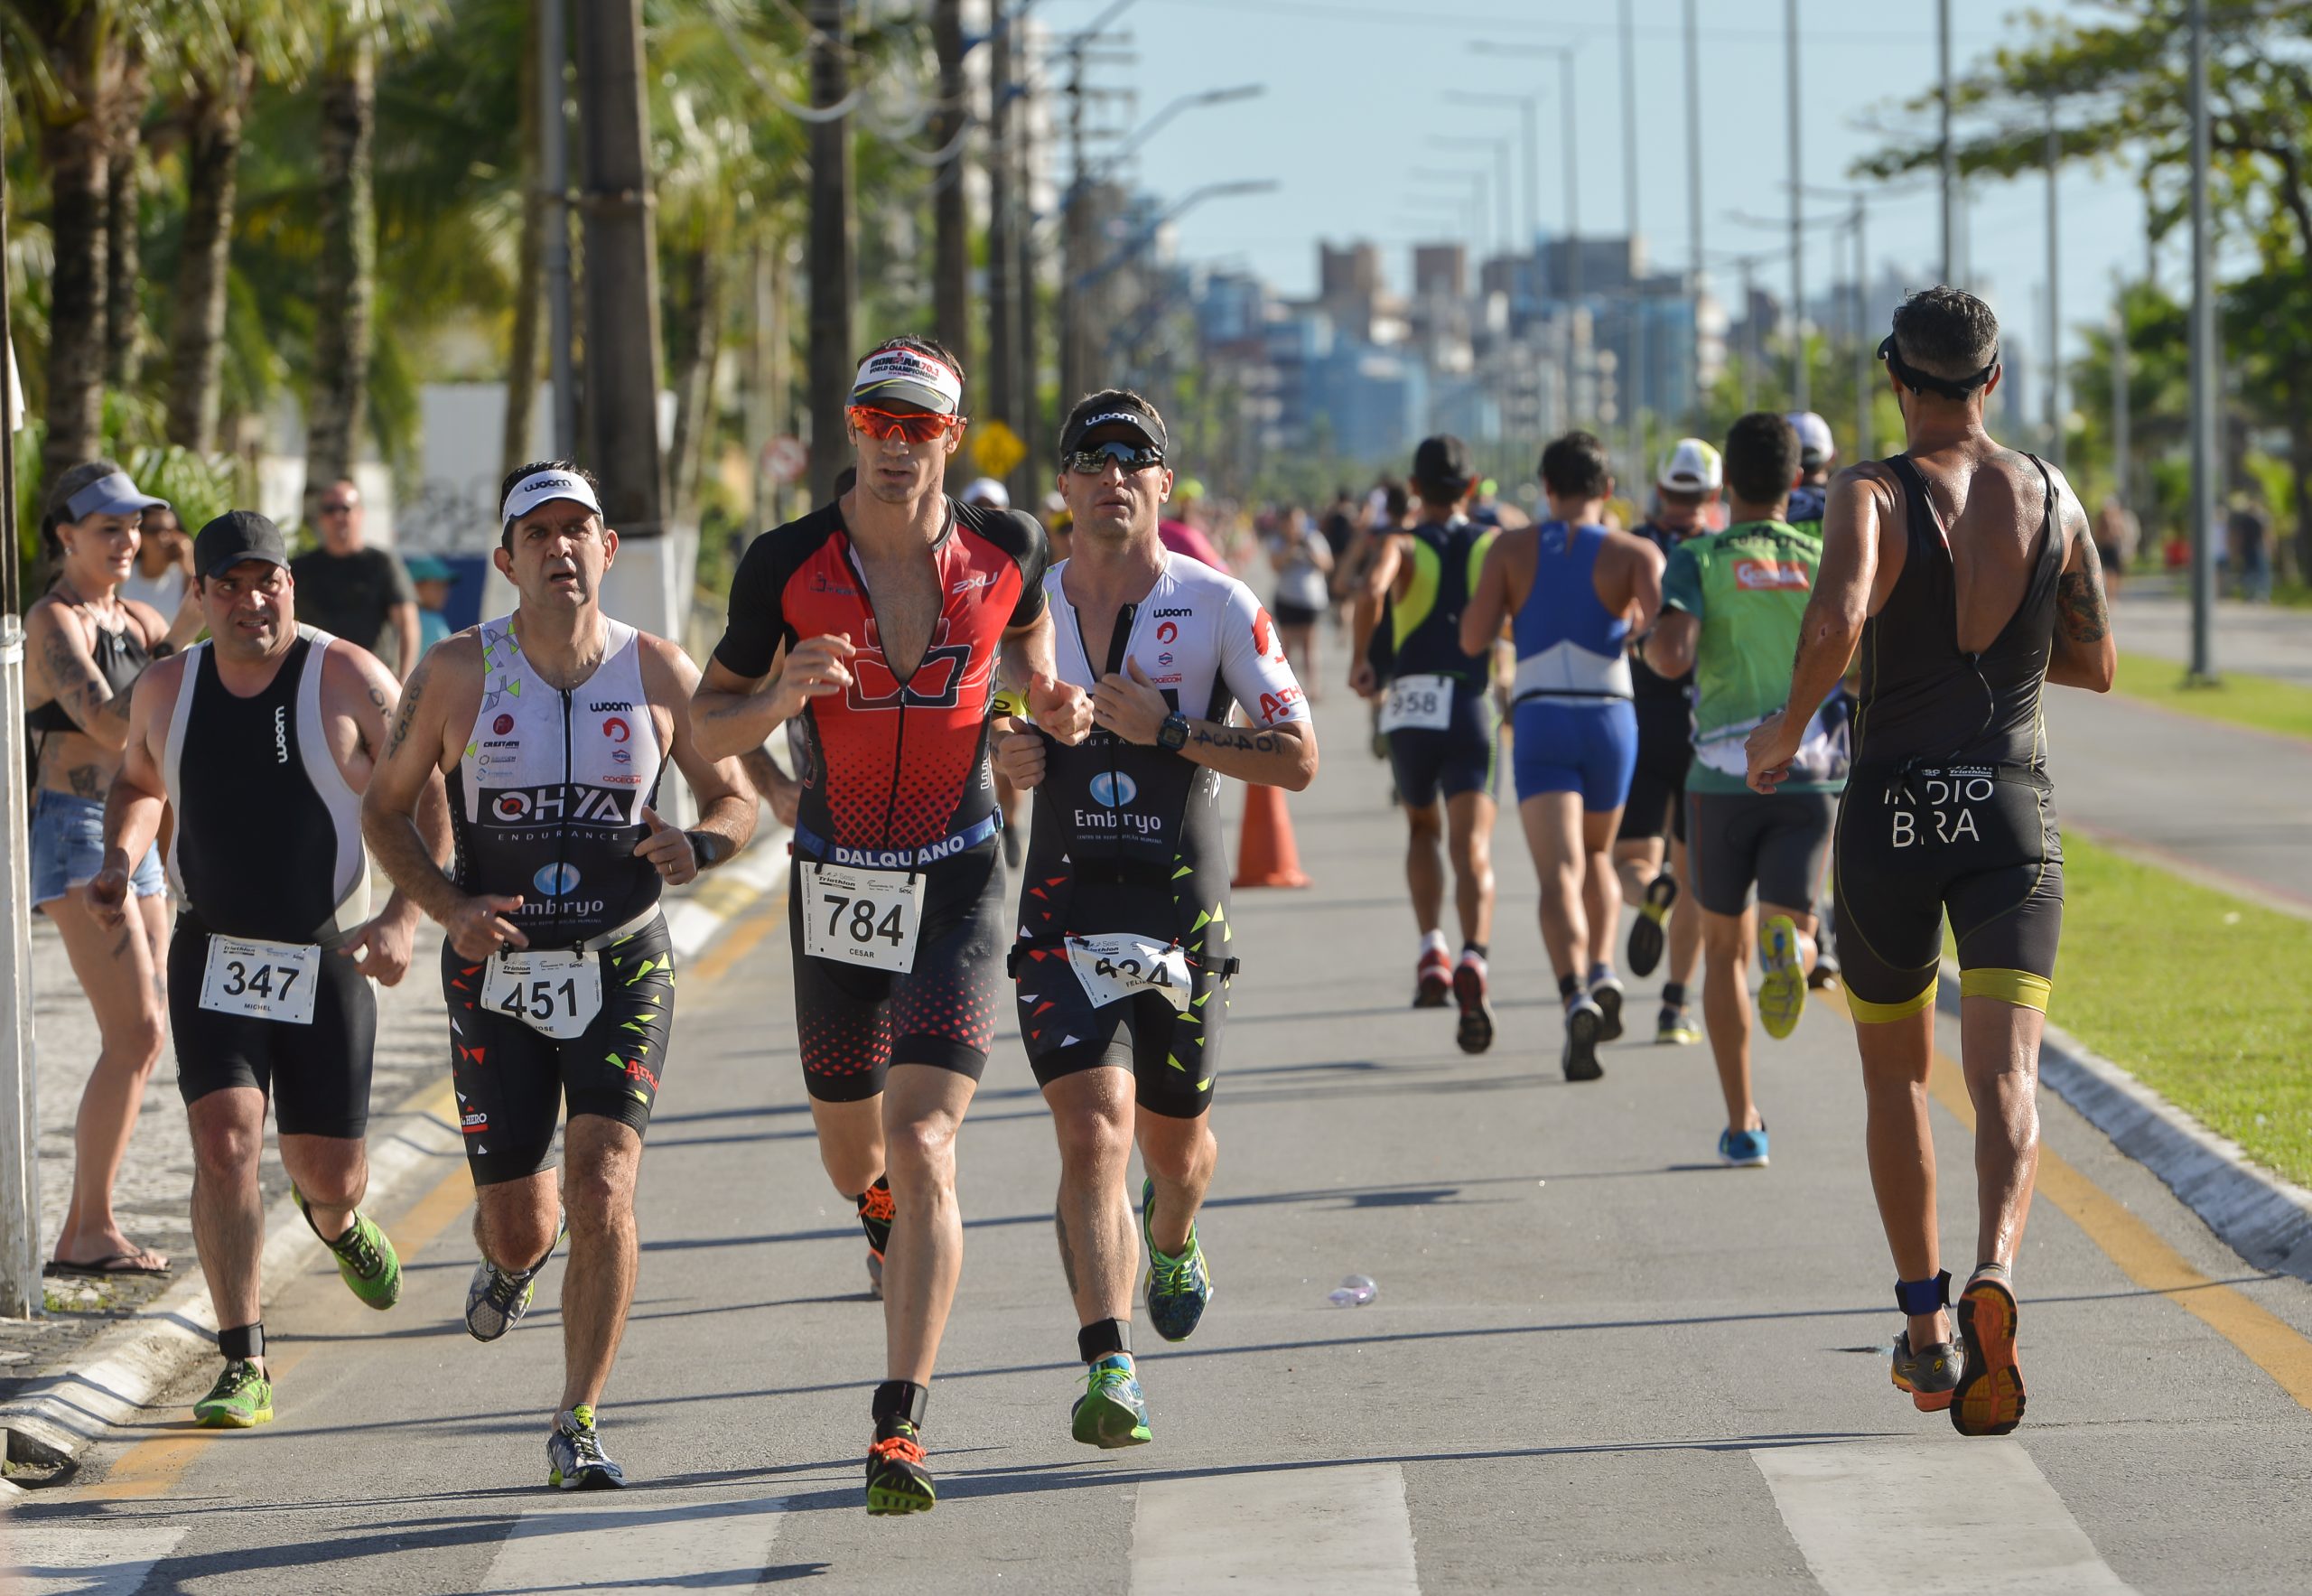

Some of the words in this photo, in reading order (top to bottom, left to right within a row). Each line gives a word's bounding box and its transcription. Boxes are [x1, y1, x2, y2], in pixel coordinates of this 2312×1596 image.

[869, 365, 890, 374] WORLD
[889, 364, 937, 381] CHAMPIONSHIP
[1086, 412, 1138, 426] woom
[524, 479, 572, 492] woom
[952, 572, 998, 594] 2XU
[1153, 608, 1192, 618] woom
[590, 702, 633, 712] woom
[275, 705, 288, 763] woom
[1074, 809, 1161, 834] Embryo
[499, 829, 619, 841] ENDURANCE
[818, 875, 856, 887] Triathlon
[824, 893, 904, 947] 784
[849, 948, 875, 958] CESAR
[223, 960, 300, 1002] 347
[500, 978, 577, 1021] 451
[244, 1003, 272, 1012] MICHEL
